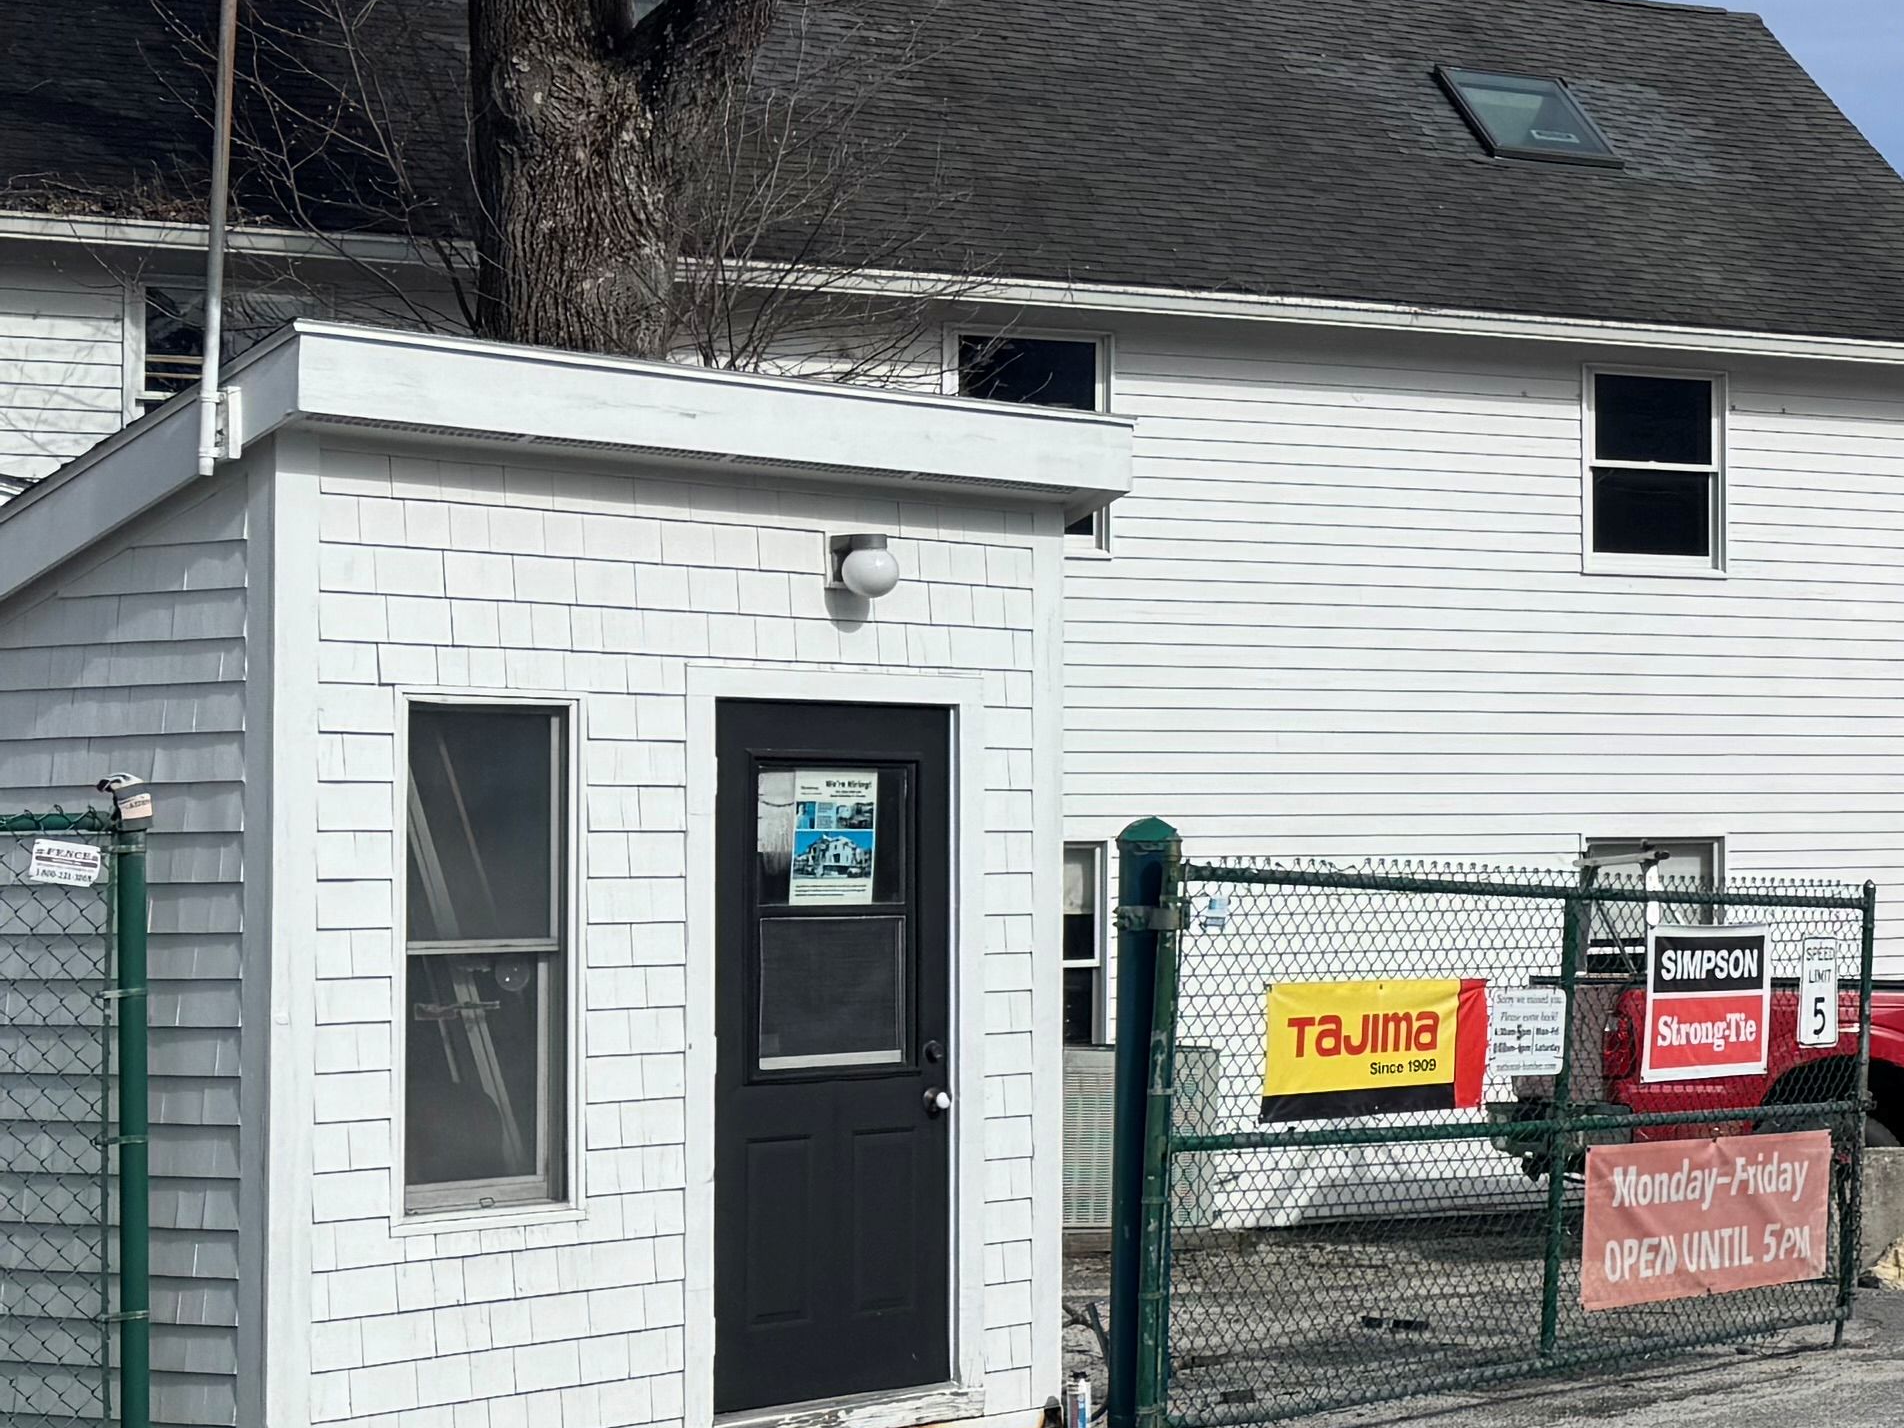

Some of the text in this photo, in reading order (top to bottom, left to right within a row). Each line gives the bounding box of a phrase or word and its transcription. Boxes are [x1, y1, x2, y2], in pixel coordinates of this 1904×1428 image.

[46, 848, 92, 860] FENCE
[1806, 946, 1835, 961] SPEED
[1660, 948, 1759, 981] SIMPSON
[1808, 968, 1832, 984] LIMIT
[1496, 994, 1514, 1007] Sorry
[1500, 1011, 1521, 1022] Please
[1813, 996, 1827, 1036] 5
[1657, 1012, 1757, 1052] Strong-Tie
[1534, 1043, 1561, 1054] Saturday
[1369, 1058, 1437, 1075] Since 1909
[1611, 1151, 1809, 1211] Monday-Friday
[1604, 1235, 1678, 1283] OPEN
[1682, 1225, 1754, 1273] UNTIL
